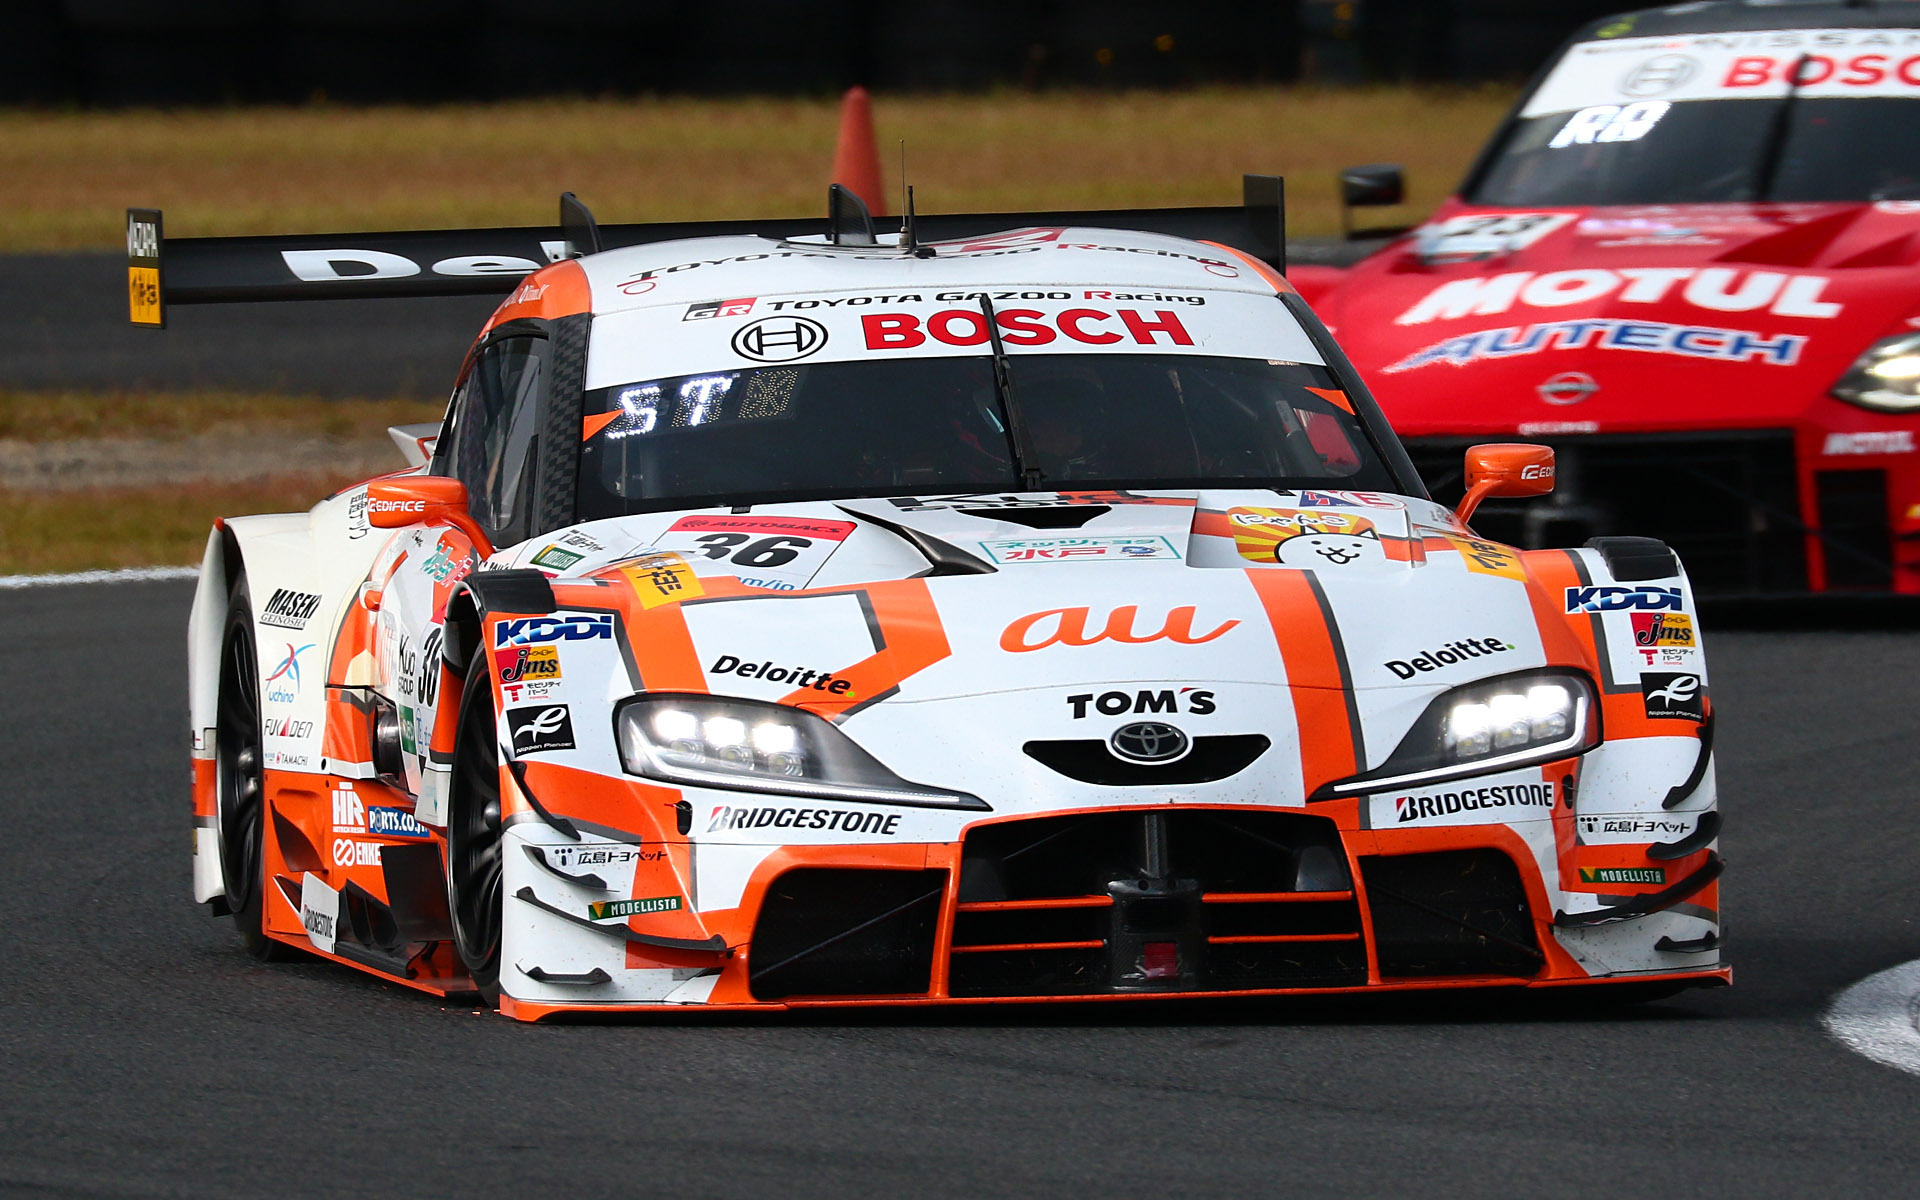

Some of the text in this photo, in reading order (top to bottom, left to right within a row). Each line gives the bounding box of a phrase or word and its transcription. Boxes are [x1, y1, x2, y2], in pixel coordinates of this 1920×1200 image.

[629, 252, 836, 280] TOYOTA
[767, 290, 1206, 311] TOYOTA GAZOO Racing
[1395, 267, 1843, 325] MOTUL
[861, 308, 1196, 351] BOSCH
[1382, 319, 1808, 374] AUTECH
[376, 500, 426, 512] EDIFICE
[710, 520, 843, 533] AUTOBACS
[694, 532, 813, 568] 36
[1004, 546, 1108, 560] 水戸
[264, 588, 322, 619] MASEKI
[1566, 586, 1682, 613] KDDI
[260, 612, 307, 628] GEINOSHA
[496, 615, 612, 648] KDDI
[999, 605, 1242, 653] au
[1635, 613, 1693, 646] jms
[501, 649, 559, 682] jms
[268, 685, 295, 704] uchino
[1066, 687, 1217, 720] TOM'S
[281, 753, 308, 766] TAMACHI
[515, 743, 543, 754] Nippon
[1396, 784, 1554, 823] BRIDGESTONE
[707, 806, 901, 835] BRIDGESTONE
[1603, 820, 1691, 834] 広島トヨペット
[577, 850, 668, 865] 広島トヨペット
[1599, 868, 1662, 884] MODELLISTA
[610, 898, 677, 916] MODELLISTA
